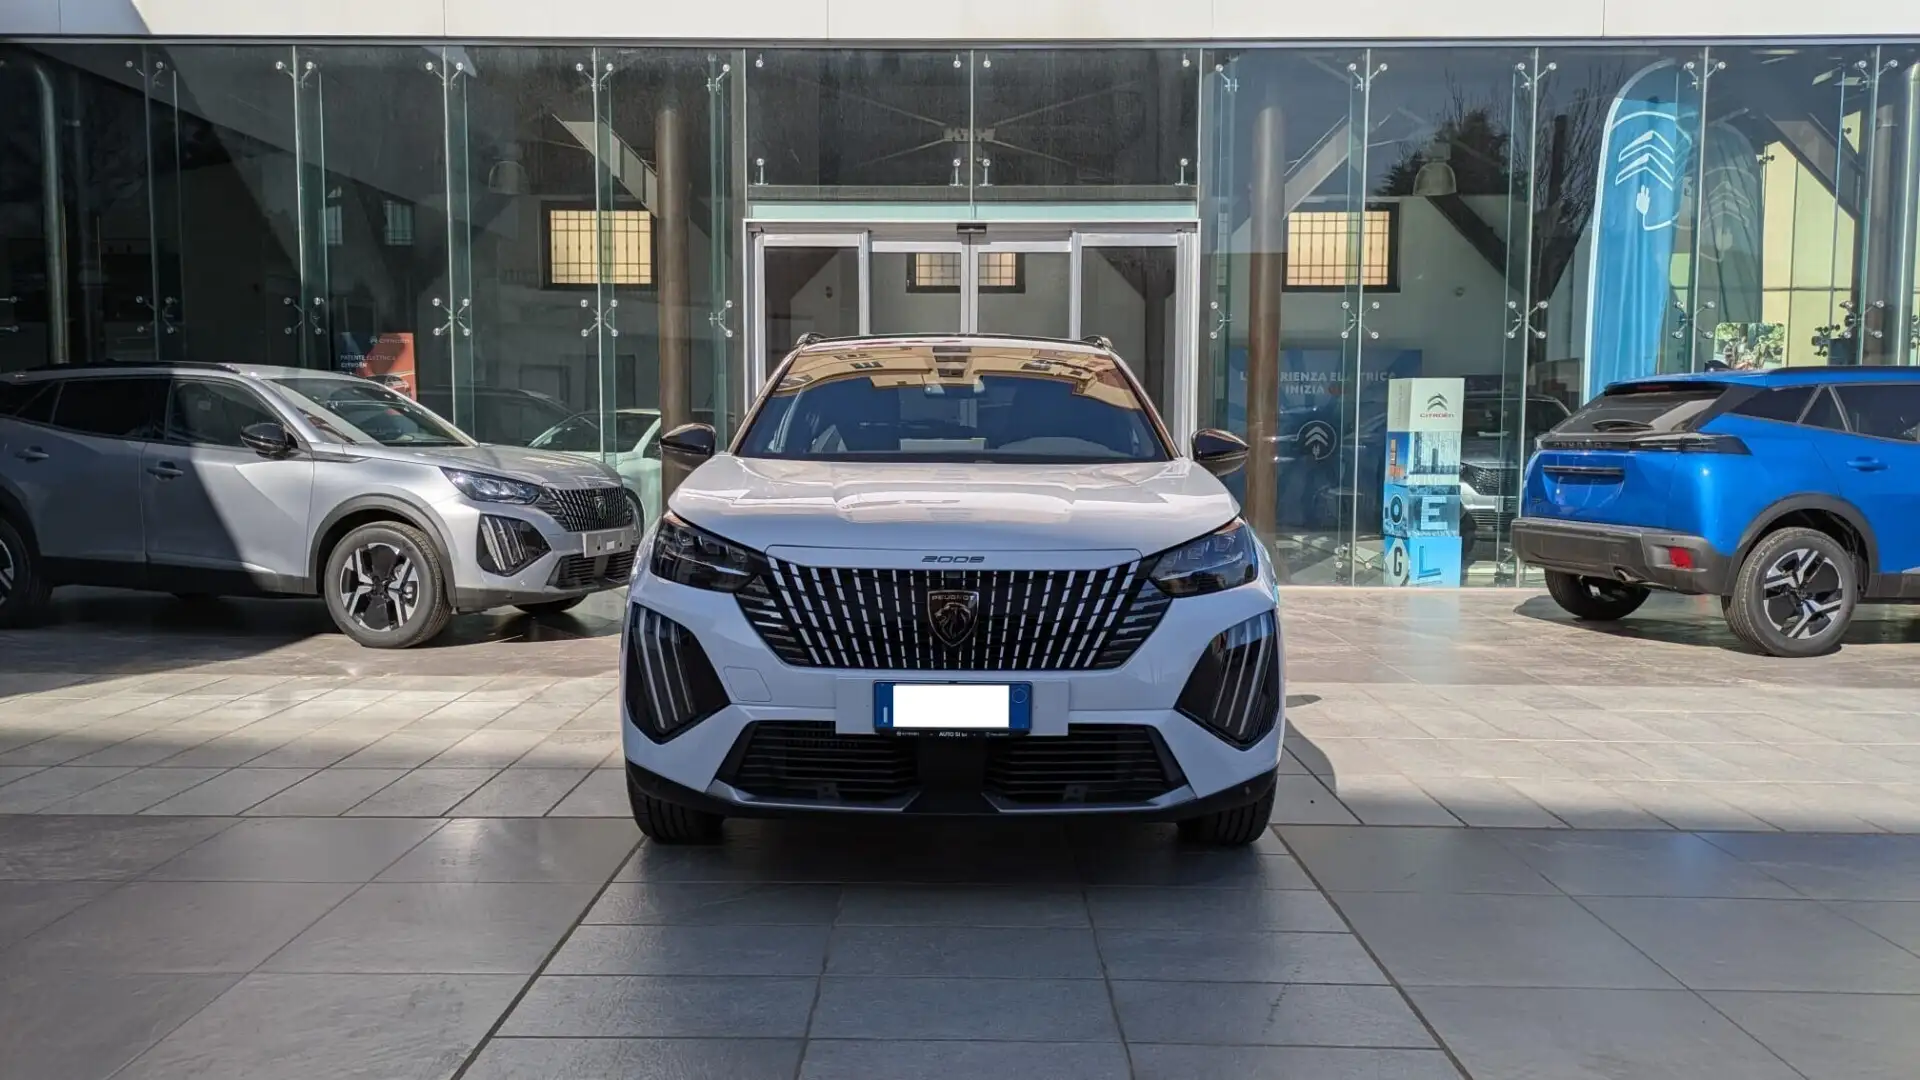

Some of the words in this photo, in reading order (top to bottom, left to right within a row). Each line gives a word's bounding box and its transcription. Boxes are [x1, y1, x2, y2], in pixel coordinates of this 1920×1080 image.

[1285, 384, 1325, 394] INIZIA
[1420, 495, 1449, 531] E
[921, 555, 985, 564] 2008
[1393, 546, 1403, 577] G
